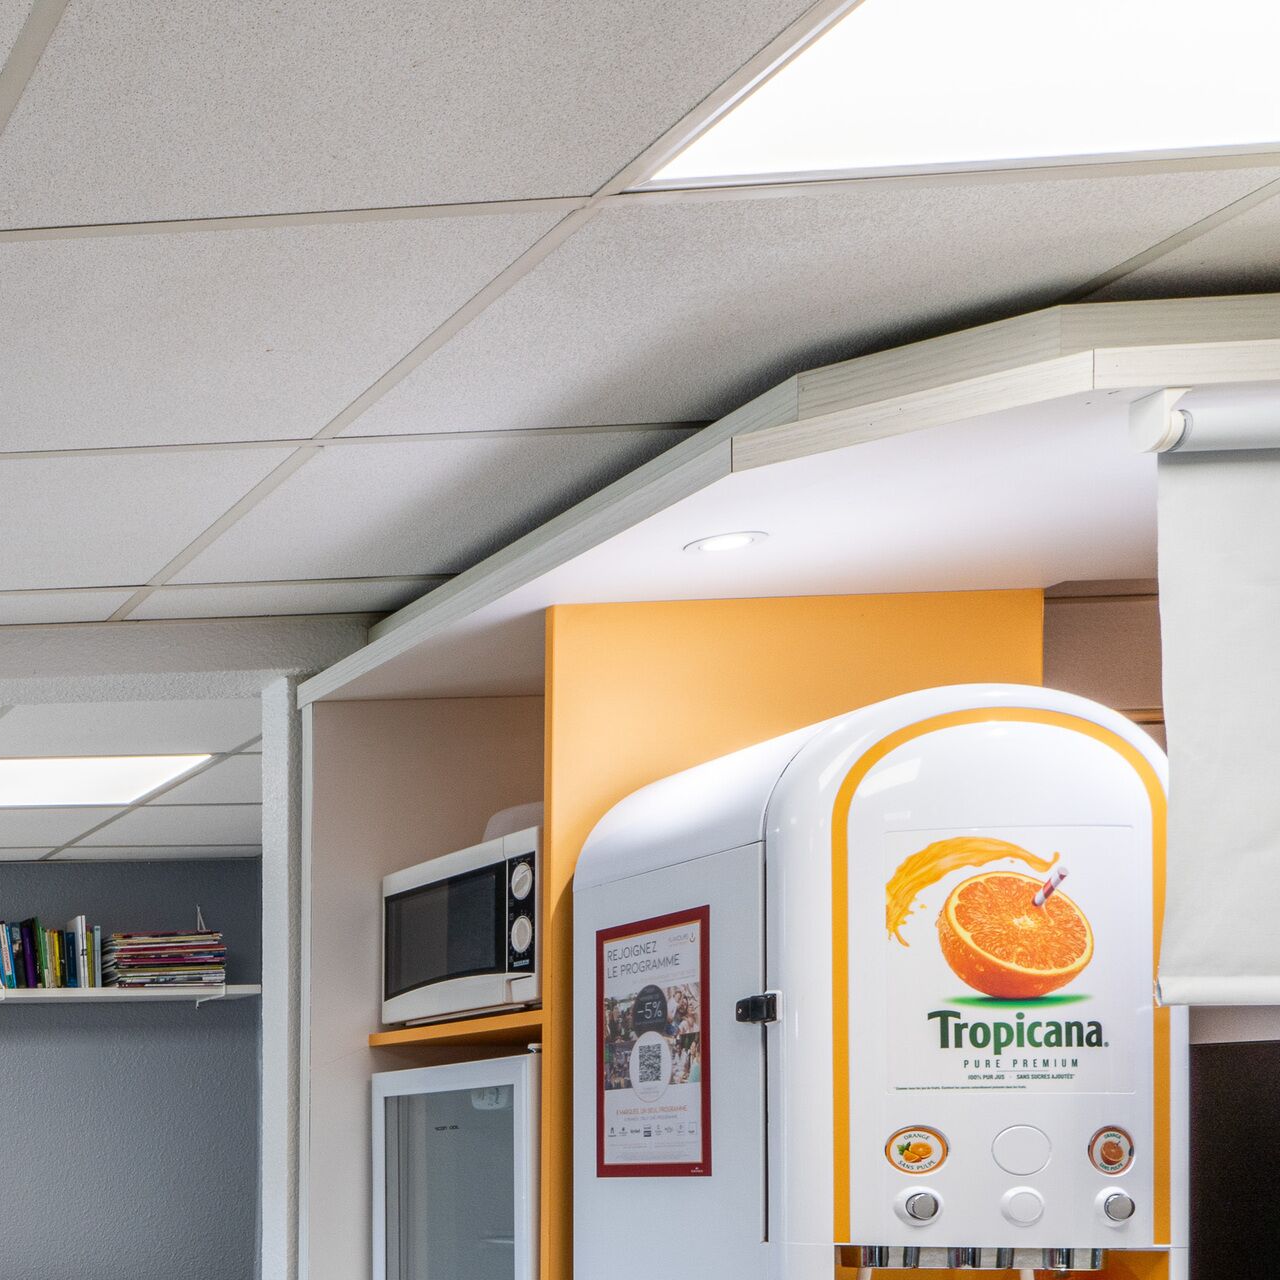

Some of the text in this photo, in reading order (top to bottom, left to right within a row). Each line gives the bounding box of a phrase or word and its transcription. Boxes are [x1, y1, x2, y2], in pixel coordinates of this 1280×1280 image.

[607, 940, 657, 962] REJOIGNEZ
[607, 965, 618, 979] LE
[620, 953, 680, 976] PROGRAMME
[637, 1001, 662, 1019] -5%
[927, 1009, 1104, 1056] Tropicana
[963, 1058, 1079, 1069] PURE PREMIUM
[903, 1133, 931, 1141] ORANGE
[898, 1160, 915, 1170] SANS
